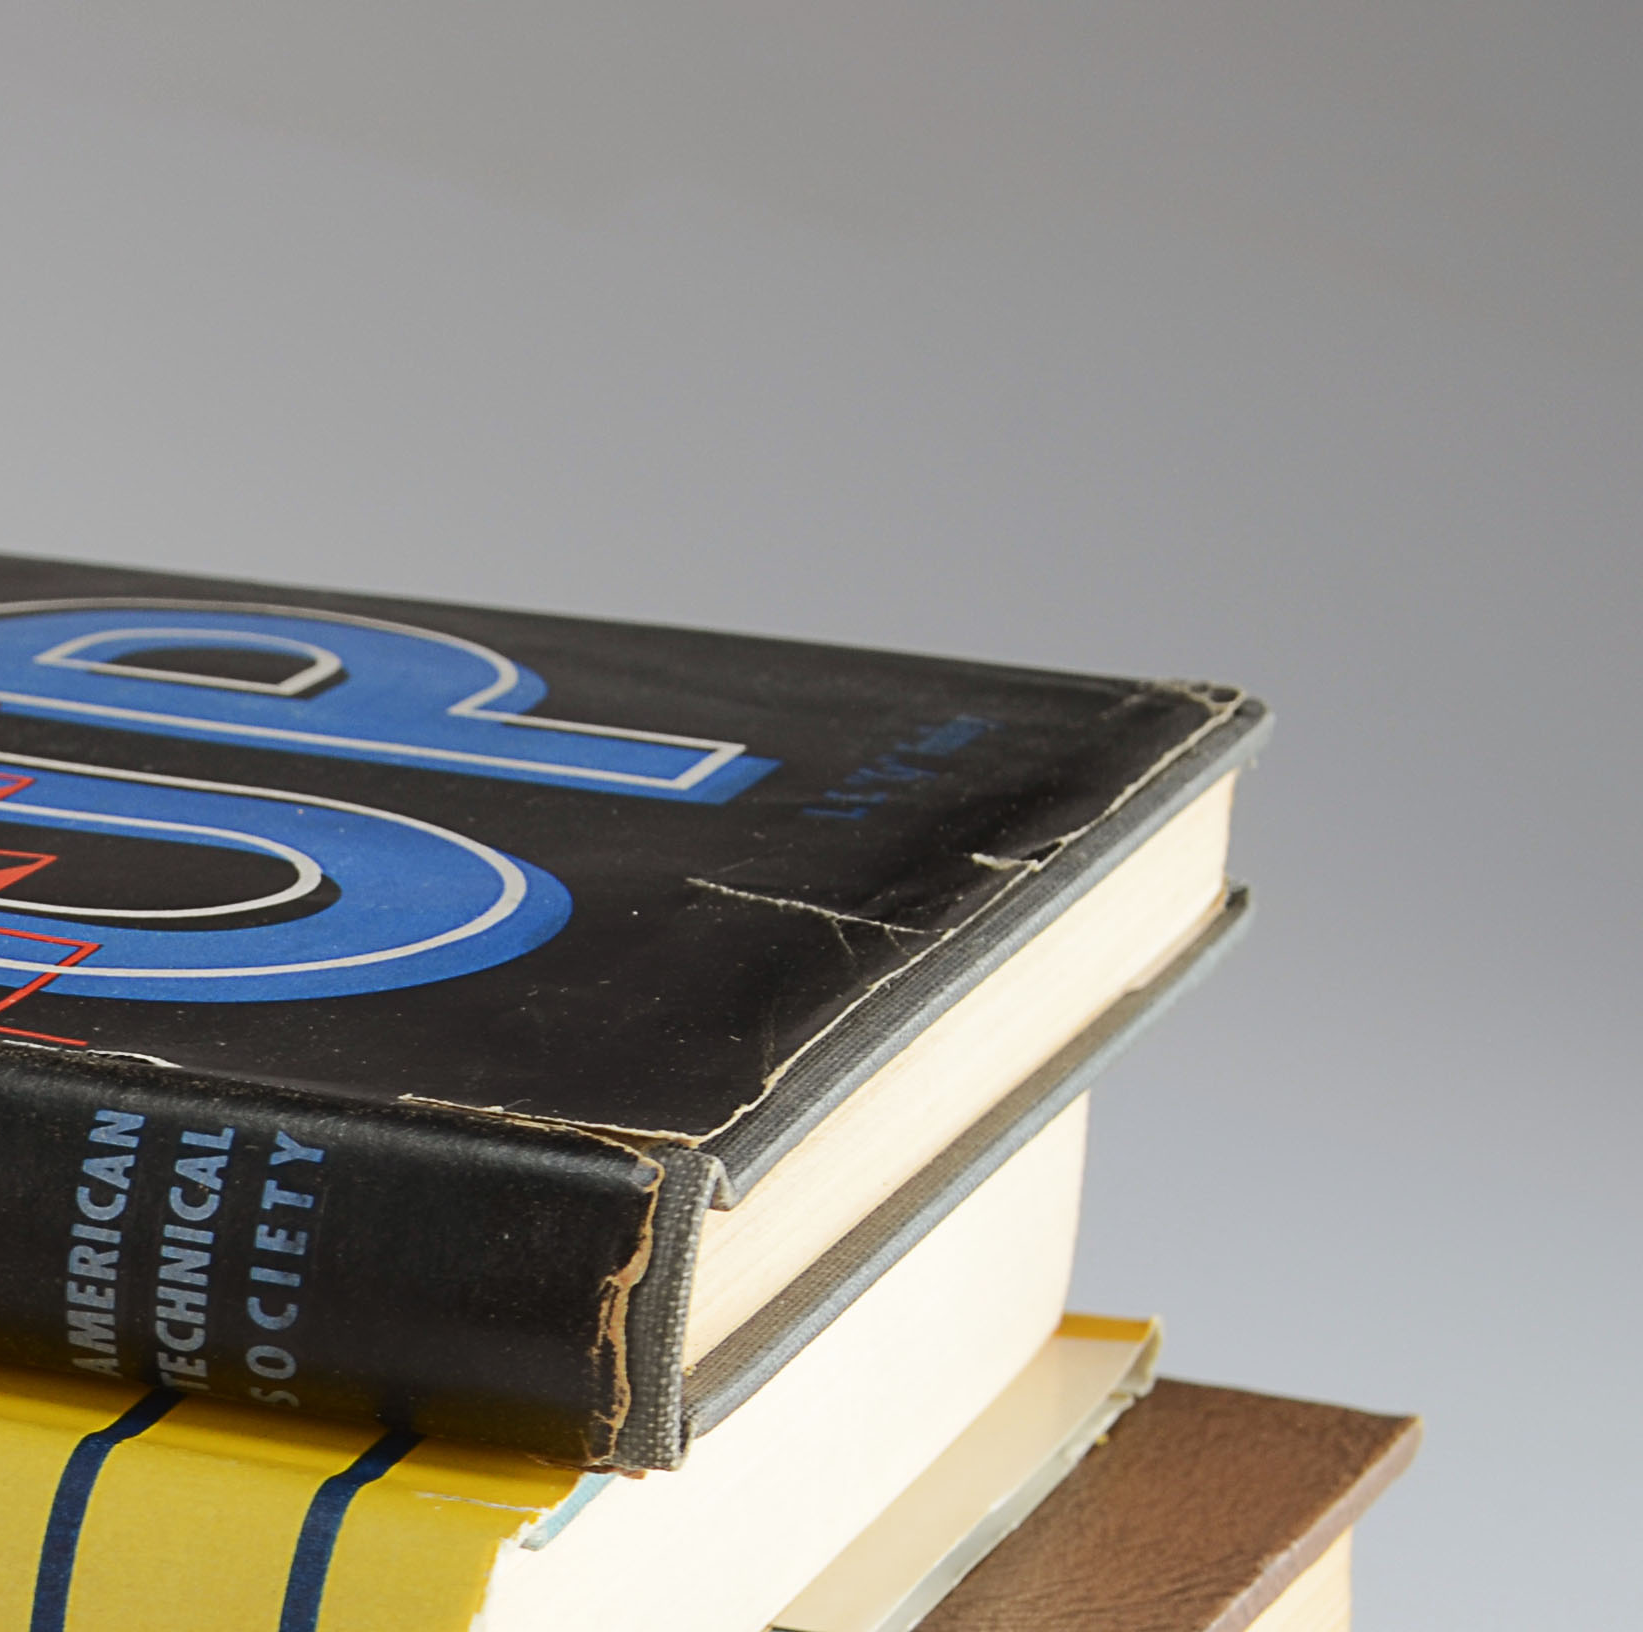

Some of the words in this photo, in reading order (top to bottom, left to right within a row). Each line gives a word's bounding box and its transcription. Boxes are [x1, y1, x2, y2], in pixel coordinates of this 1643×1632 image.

[66, 1109, 147, 1379] AMERICAN
[155, 1126, 236, 1391] TECHNICAL
[246, 1130, 326, 1409] SOCIETY
